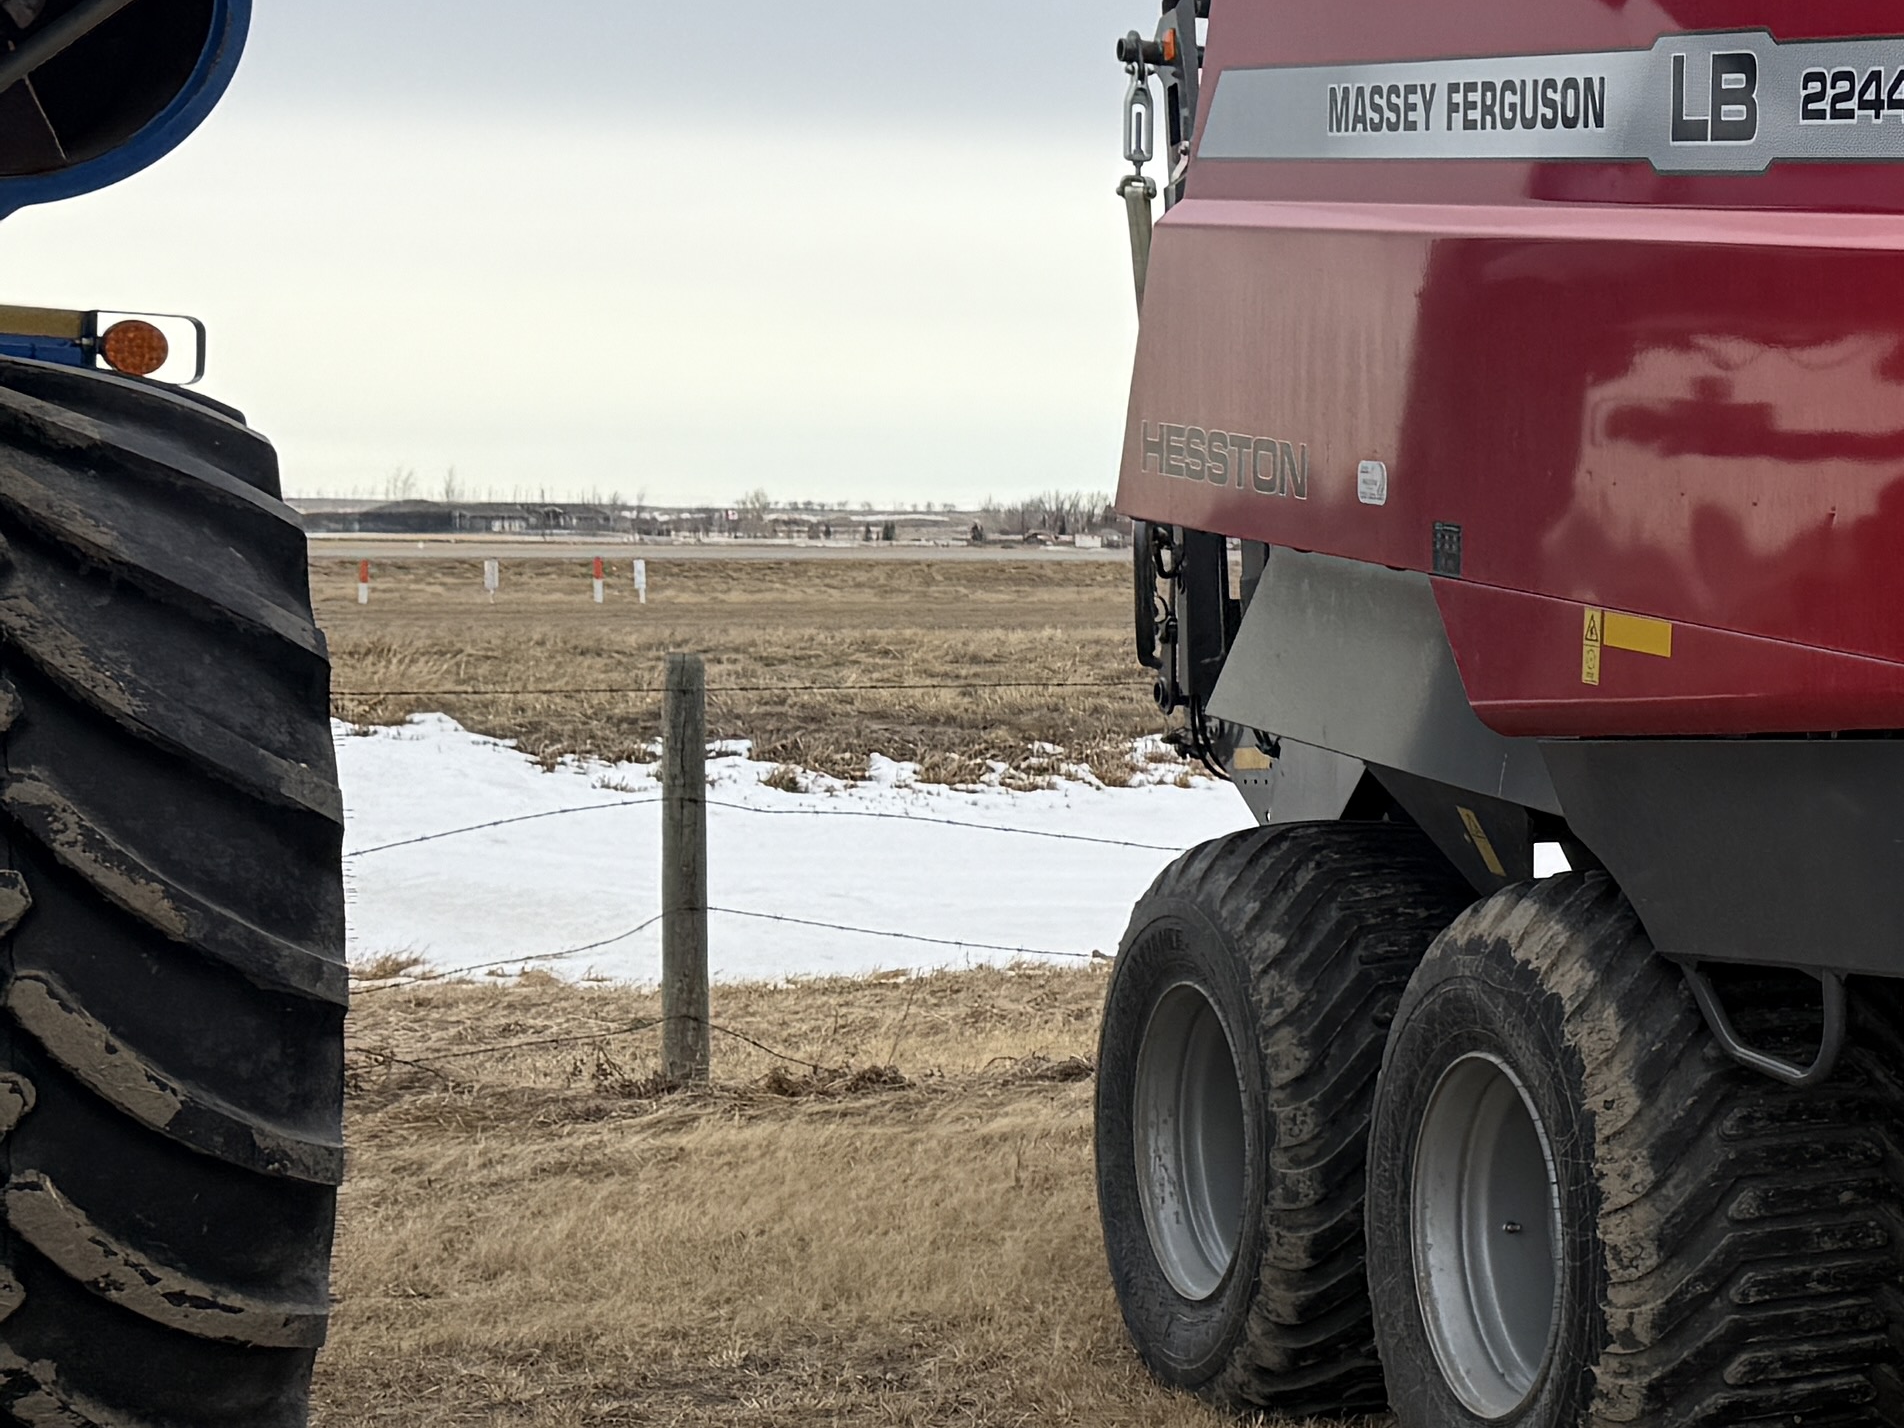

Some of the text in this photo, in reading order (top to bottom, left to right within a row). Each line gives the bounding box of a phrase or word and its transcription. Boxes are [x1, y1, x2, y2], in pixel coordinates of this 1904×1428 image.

[1327, 82, 1436, 133] MASSEY
[1446, 76, 1606, 132] FERGUSON
[1671, 51, 1759, 146] LB
[1141, 419, 1307, 501] HESSTON
